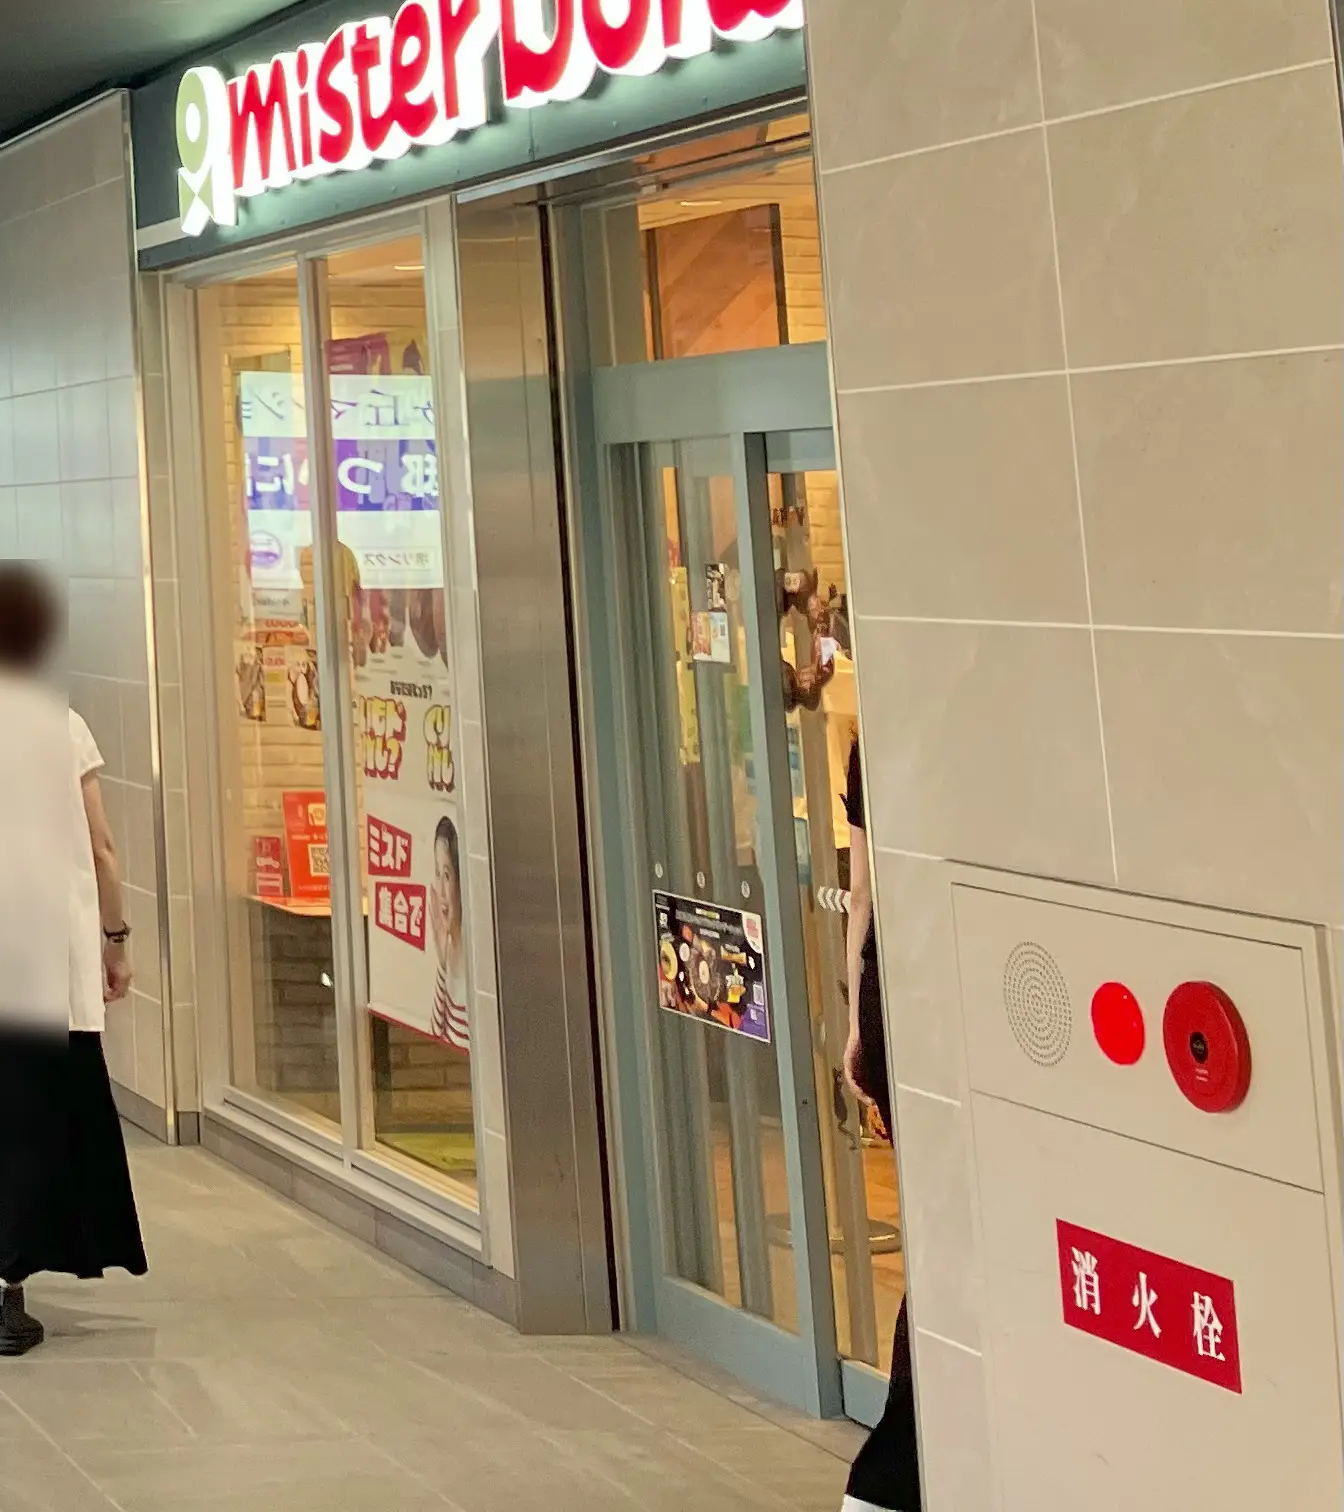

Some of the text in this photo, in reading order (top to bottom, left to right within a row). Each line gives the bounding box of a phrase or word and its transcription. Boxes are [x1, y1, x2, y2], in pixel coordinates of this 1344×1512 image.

[369, 821, 409, 872] ミスド
[378, 885, 423, 938] 集合で
[1070, 1245, 1226, 1364] 消火栓
